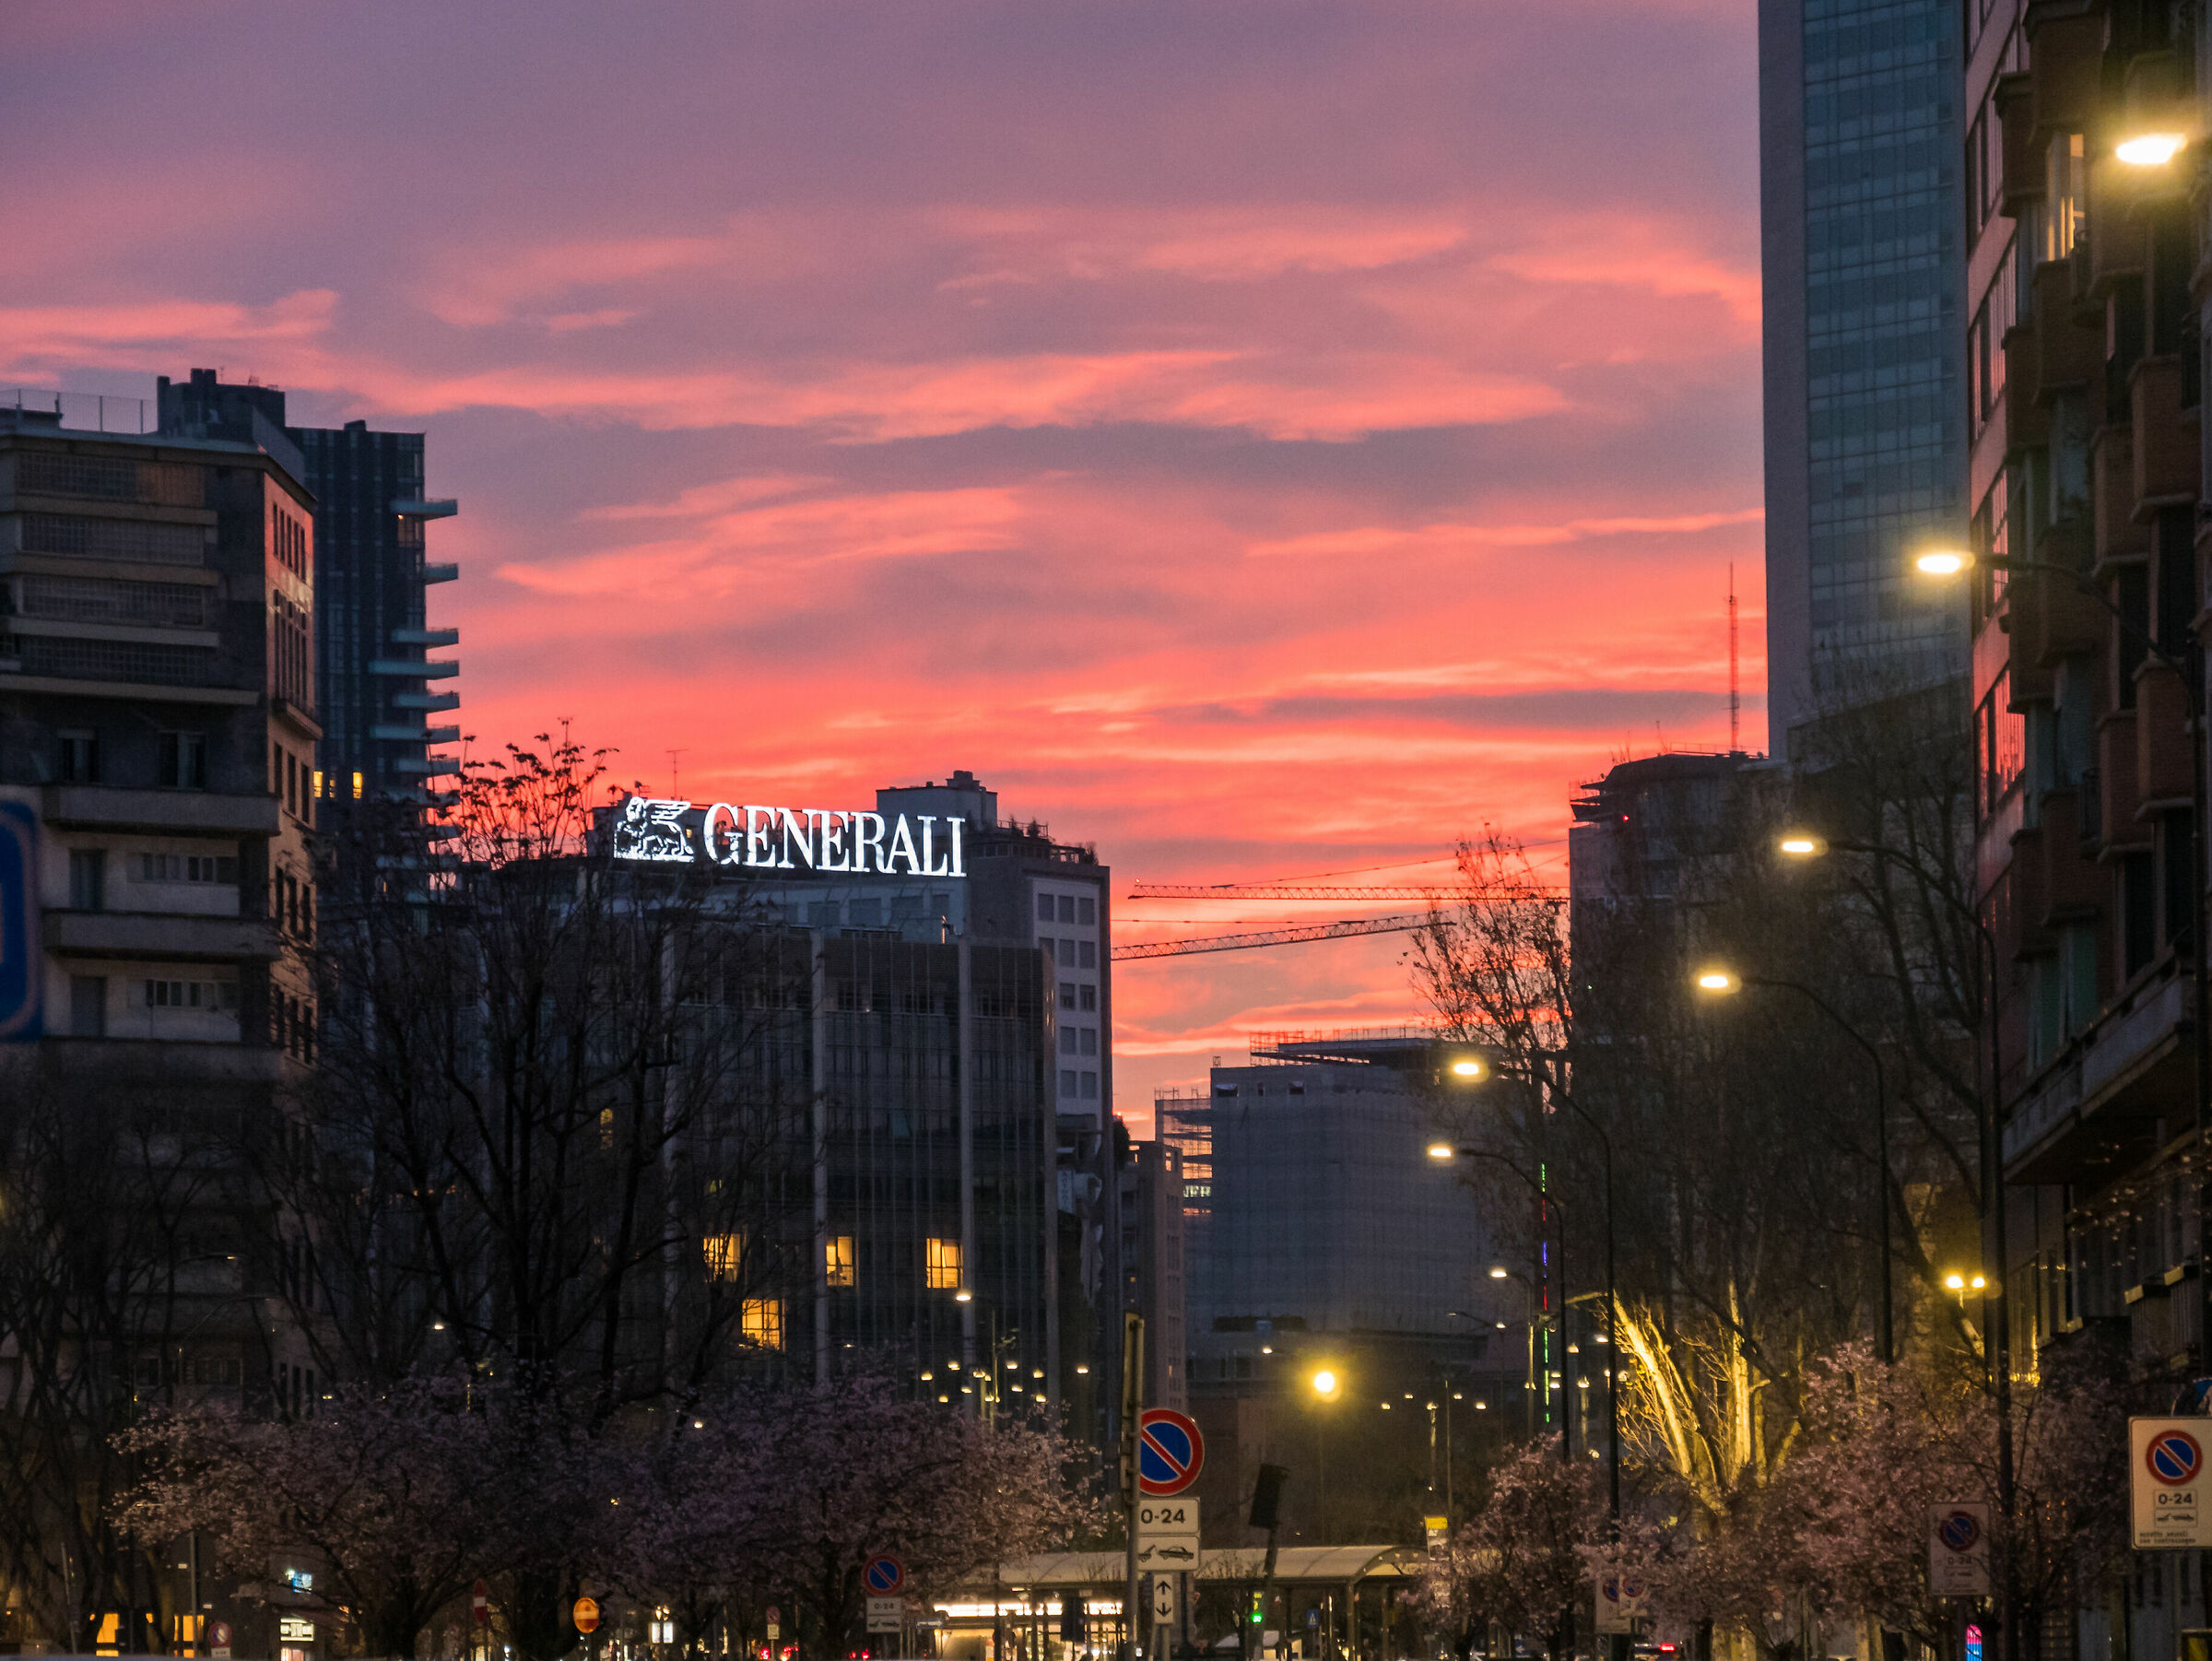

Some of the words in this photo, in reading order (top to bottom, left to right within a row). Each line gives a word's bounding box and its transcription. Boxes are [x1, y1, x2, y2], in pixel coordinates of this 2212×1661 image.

[703, 802, 967, 877] GENERALI
[2159, 1493, 2193, 1504] 0-24
[1141, 1508, 1185, 1524] 0-24
